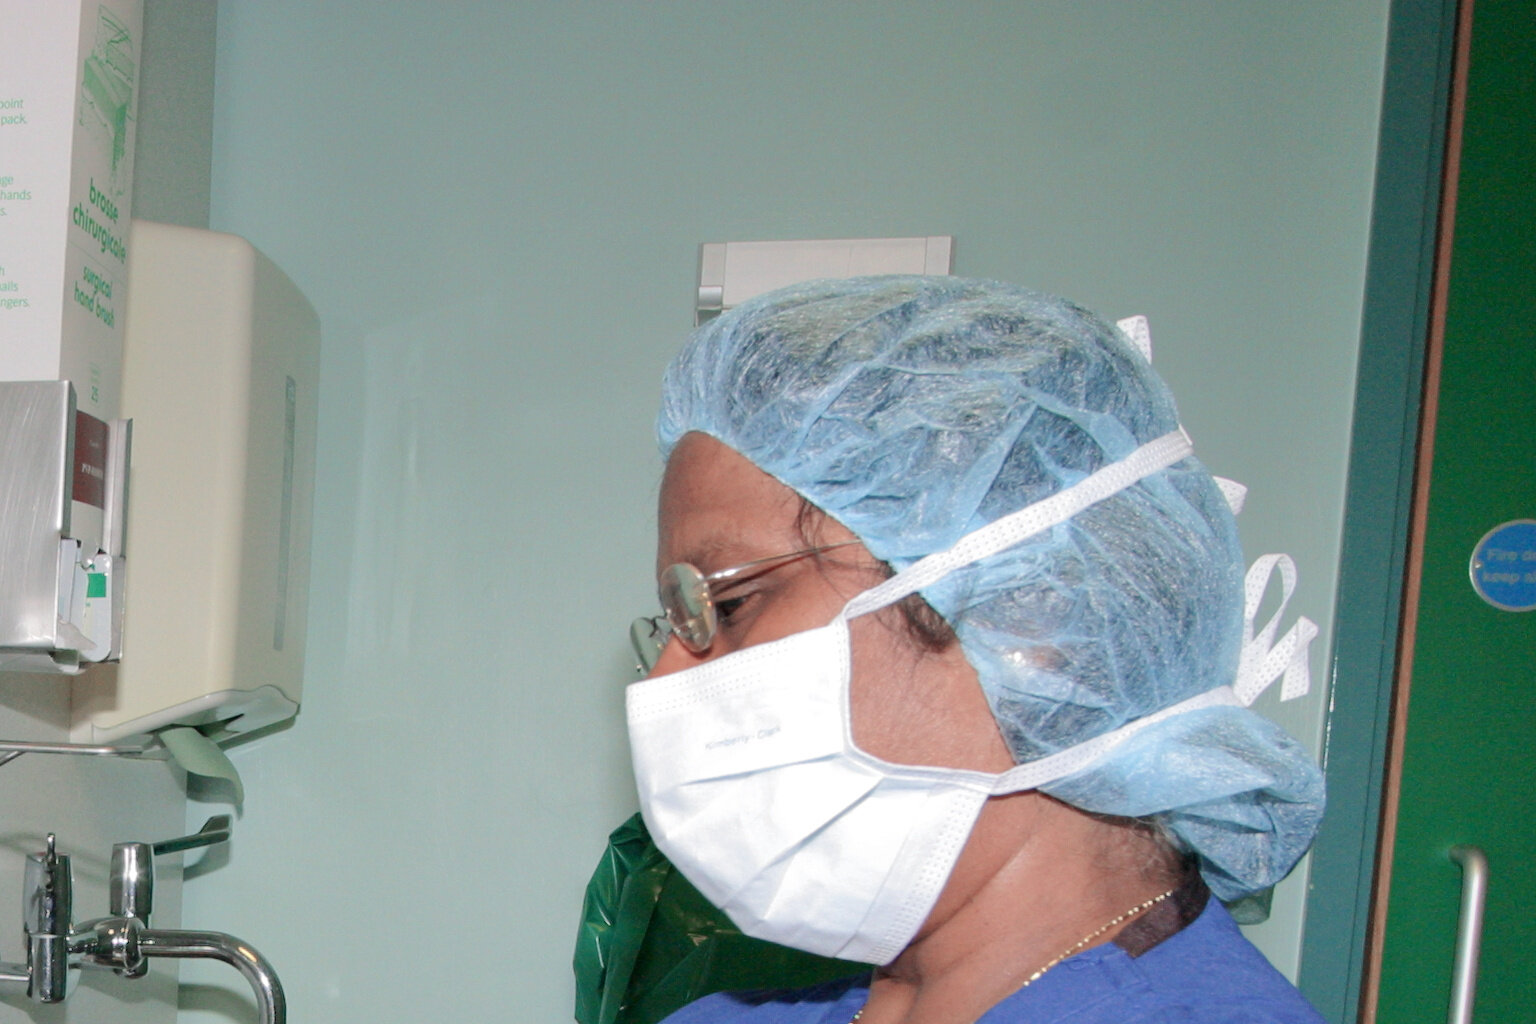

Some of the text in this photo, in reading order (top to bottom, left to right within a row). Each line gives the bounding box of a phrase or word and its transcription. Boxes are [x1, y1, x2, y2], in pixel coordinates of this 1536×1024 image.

[1, 113, 28, 127] pack.
[0, 189, 32, 201] hands
[89, 177, 119, 224] brosse
[72, 202, 127, 265] chirurgicale
[82, 265, 112, 300] surgical
[74, 279, 115, 330] hand brush
